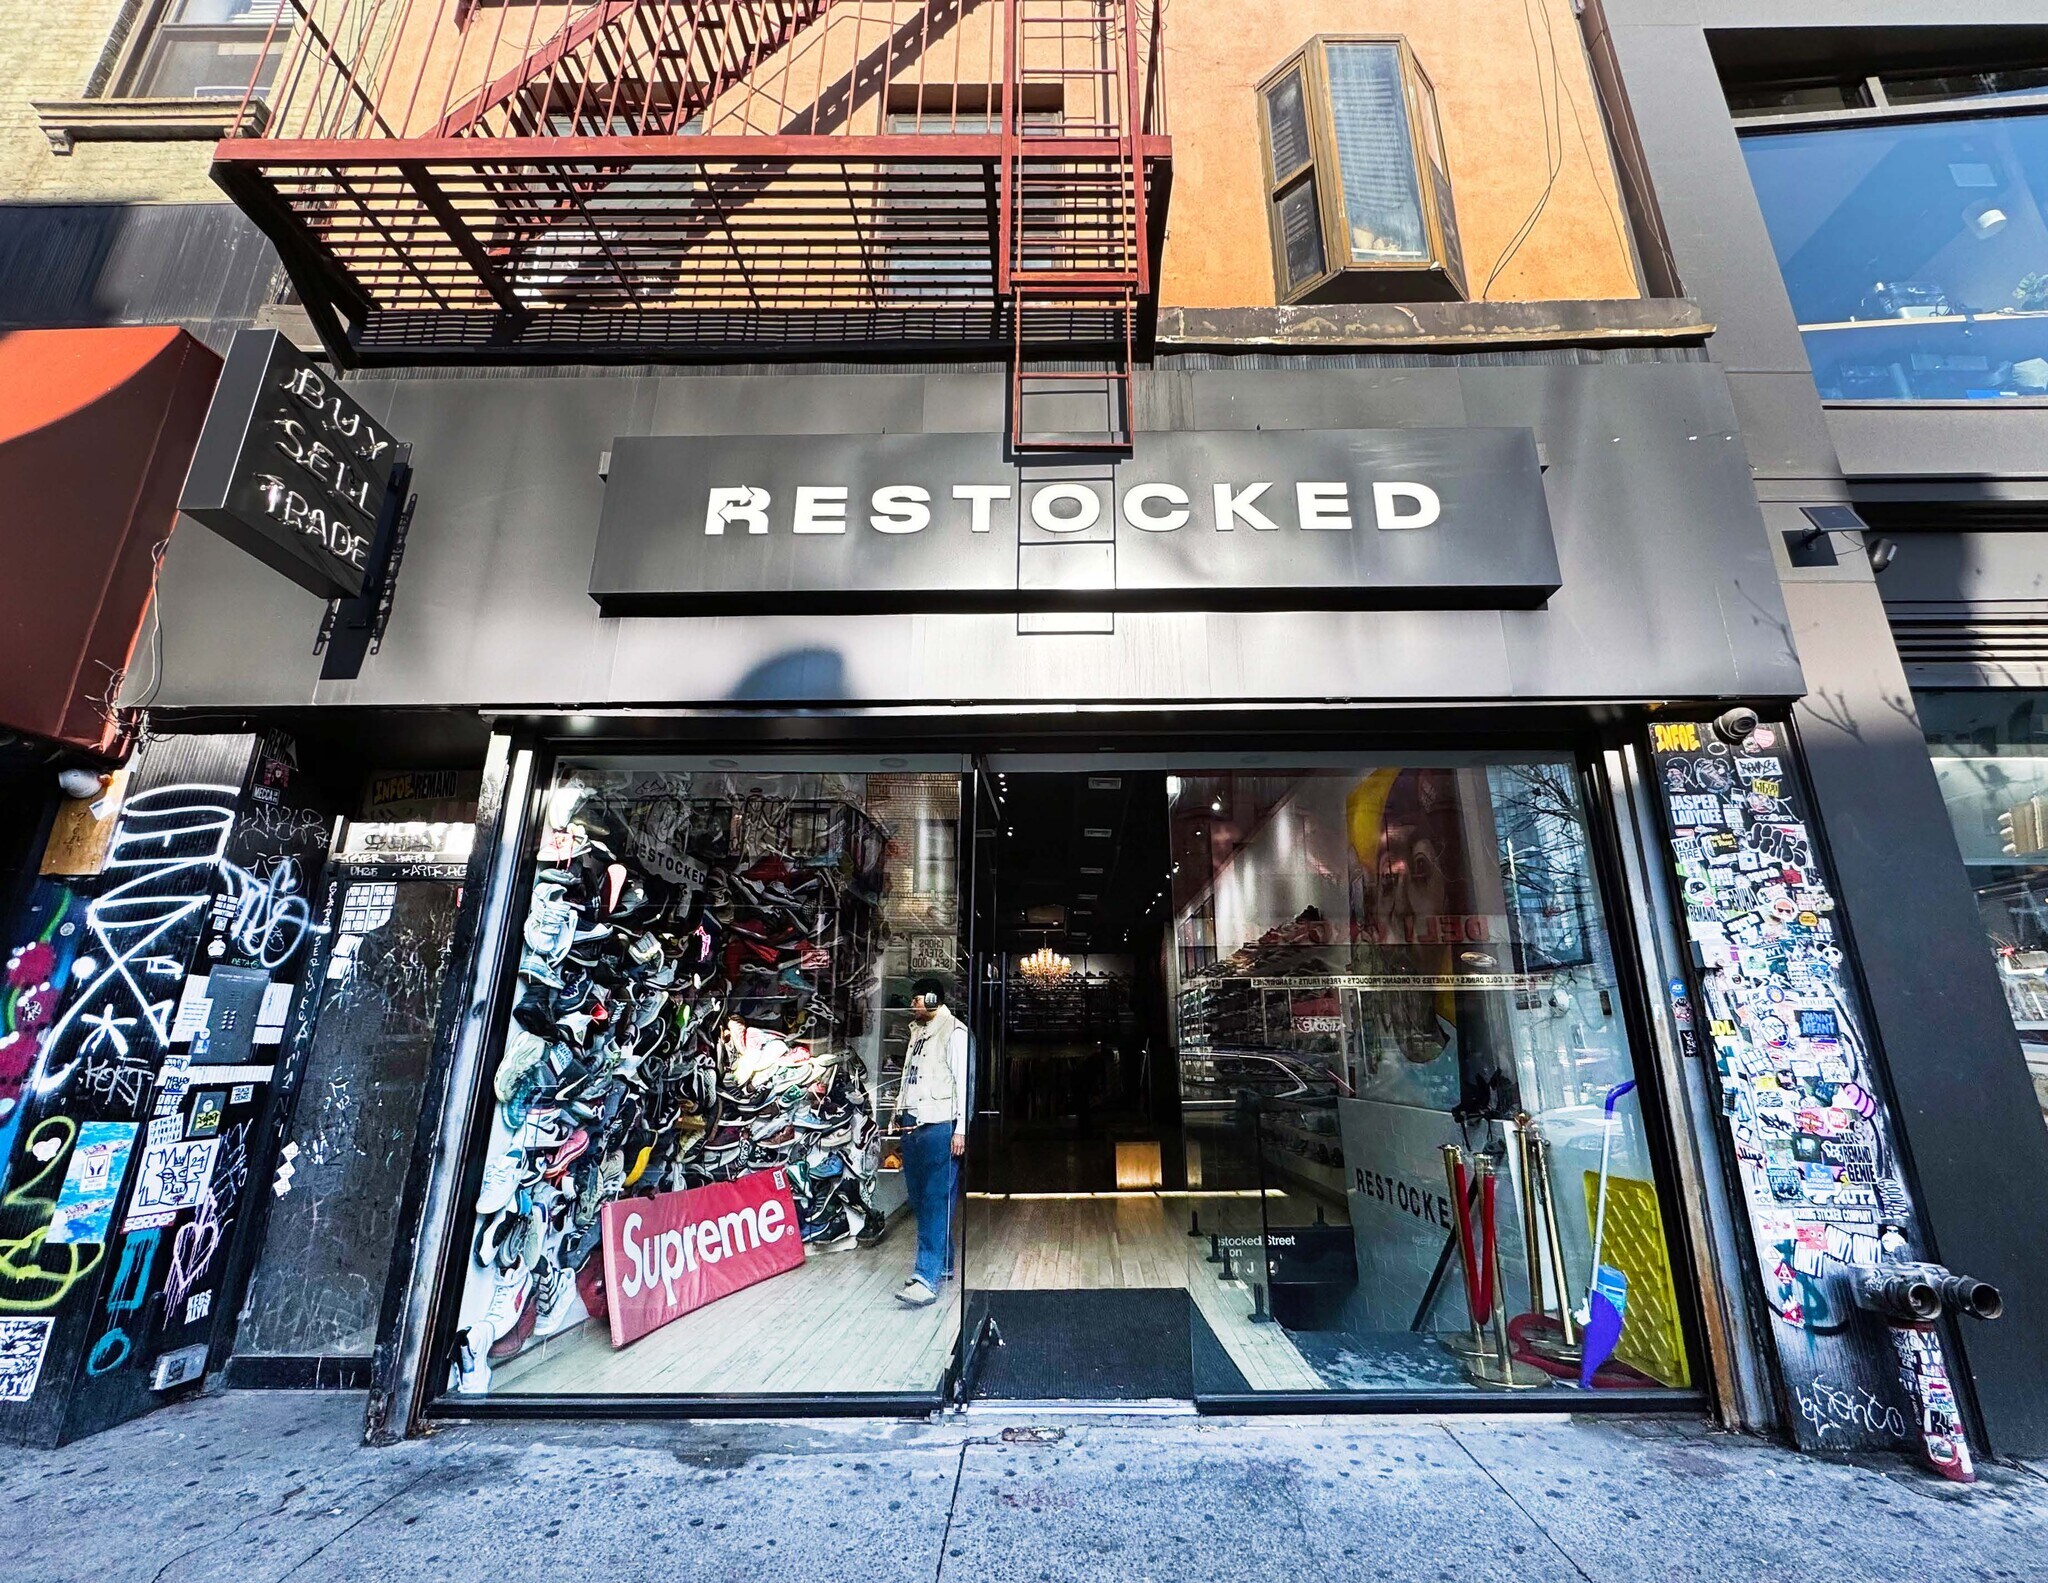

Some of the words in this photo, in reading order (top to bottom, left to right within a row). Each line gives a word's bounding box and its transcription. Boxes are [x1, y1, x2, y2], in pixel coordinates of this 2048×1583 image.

[280, 368, 389, 461] BUY
[275, 419, 377, 520] SELL
[704, 481, 1441, 536] RESTOCKED
[253, 472, 370, 572] TRADE
[1669, 794, 1720, 810] JASPER
[1672, 810, 1723, 825] LADYDEE
[1675, 840, 1695, 851] HOT
[1679, 851, 1700, 861] FIRE
[1688, 904, 1718, 922] REMAND
[1844, 1146, 1873, 1164] REMAND
[1847, 1165, 1878, 1183] GENIE
[1355, 1168, 1454, 1229] RESTOCKE
[1843, 1209, 1871, 1223] COMPANY
[1267, 1234, 1296, 1247] Street
[622, 1199, 785, 1306] Supreme
